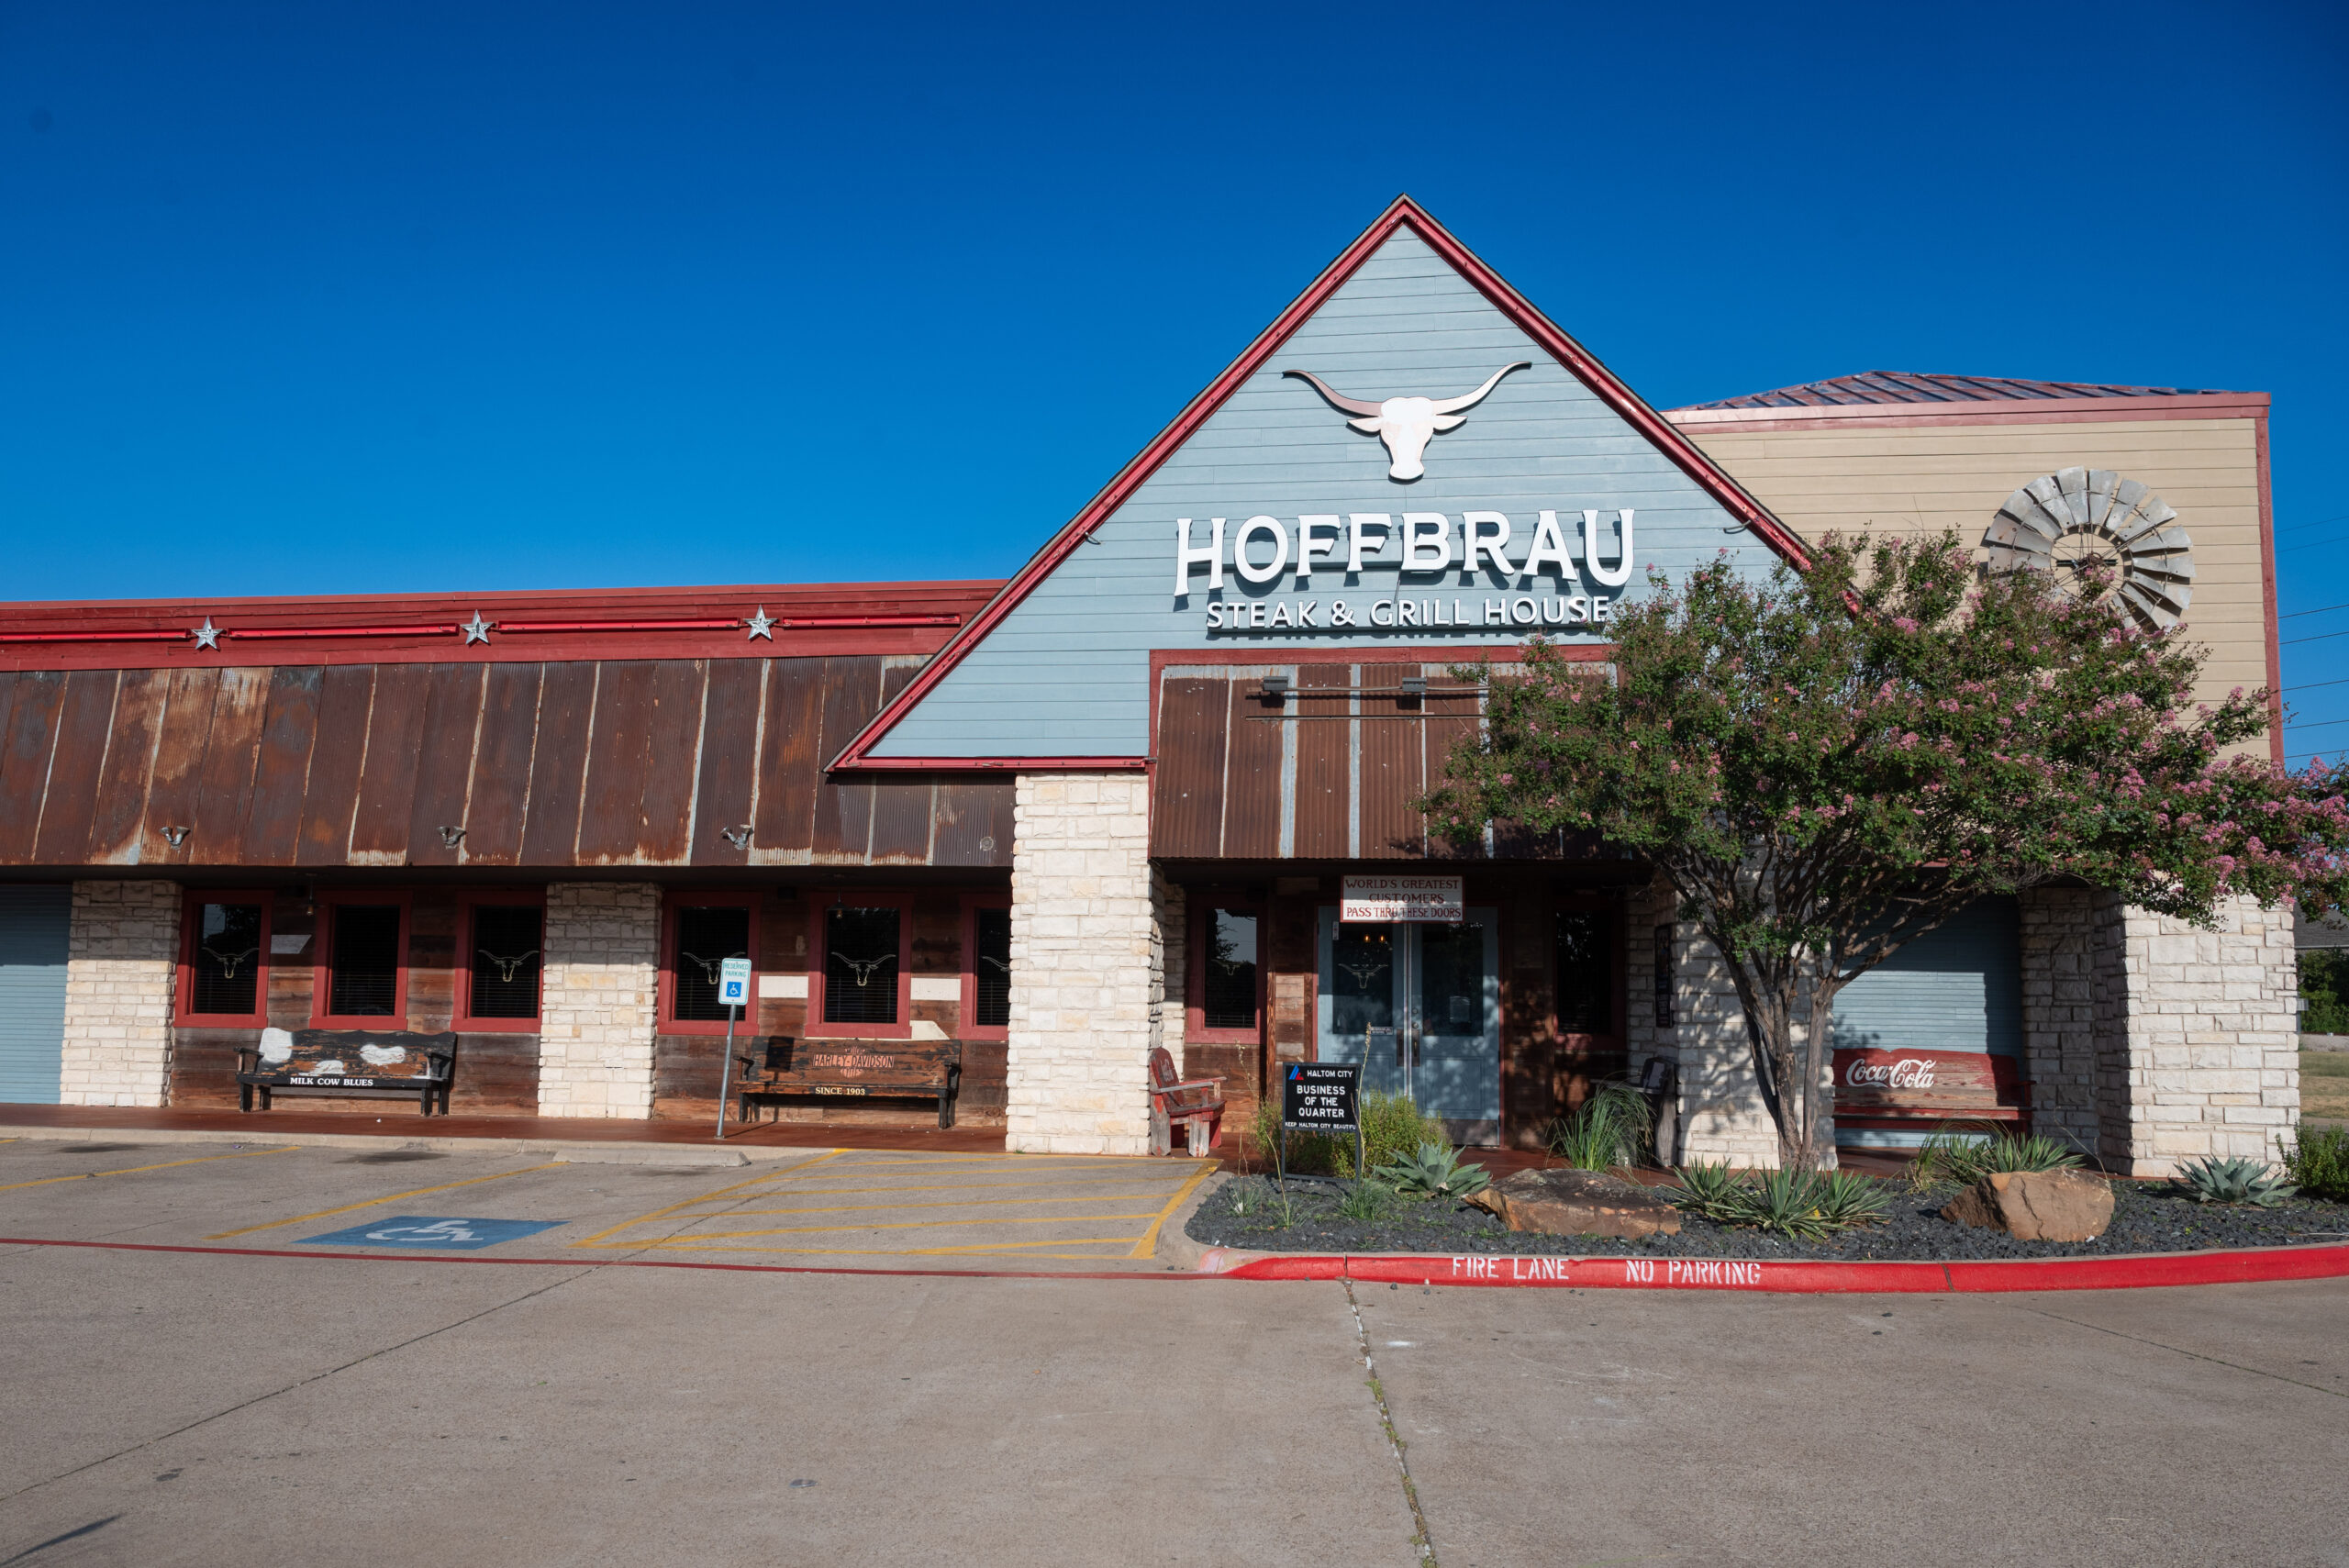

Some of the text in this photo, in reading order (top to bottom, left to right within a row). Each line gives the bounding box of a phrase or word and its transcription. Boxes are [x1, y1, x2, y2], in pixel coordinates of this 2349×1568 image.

[1174, 508, 1635, 597] HOFFBRAU
[1207, 595, 1609, 628] STEAK & GRILL HOUSE
[1345, 879, 1460, 889] WORLD'S GREATEST
[1368, 893, 1445, 904] CUSTOMERS
[1346, 906, 1462, 918] PASS THRU THESE DOORS
[813, 1054, 894, 1068] HARLEY-DAVIDSON
[1845, 1058, 1937, 1088] Coca-Cola
[815, 1086, 865, 1095] SINCE 1903
[1297, 1084, 1346, 1095] BUSINESS
[1304, 1096, 1338, 1106] OF THE
[1298, 1107, 1345, 1118] QUARTER
[1453, 1257, 1762, 1285] FIRE LANE NO PARKING
